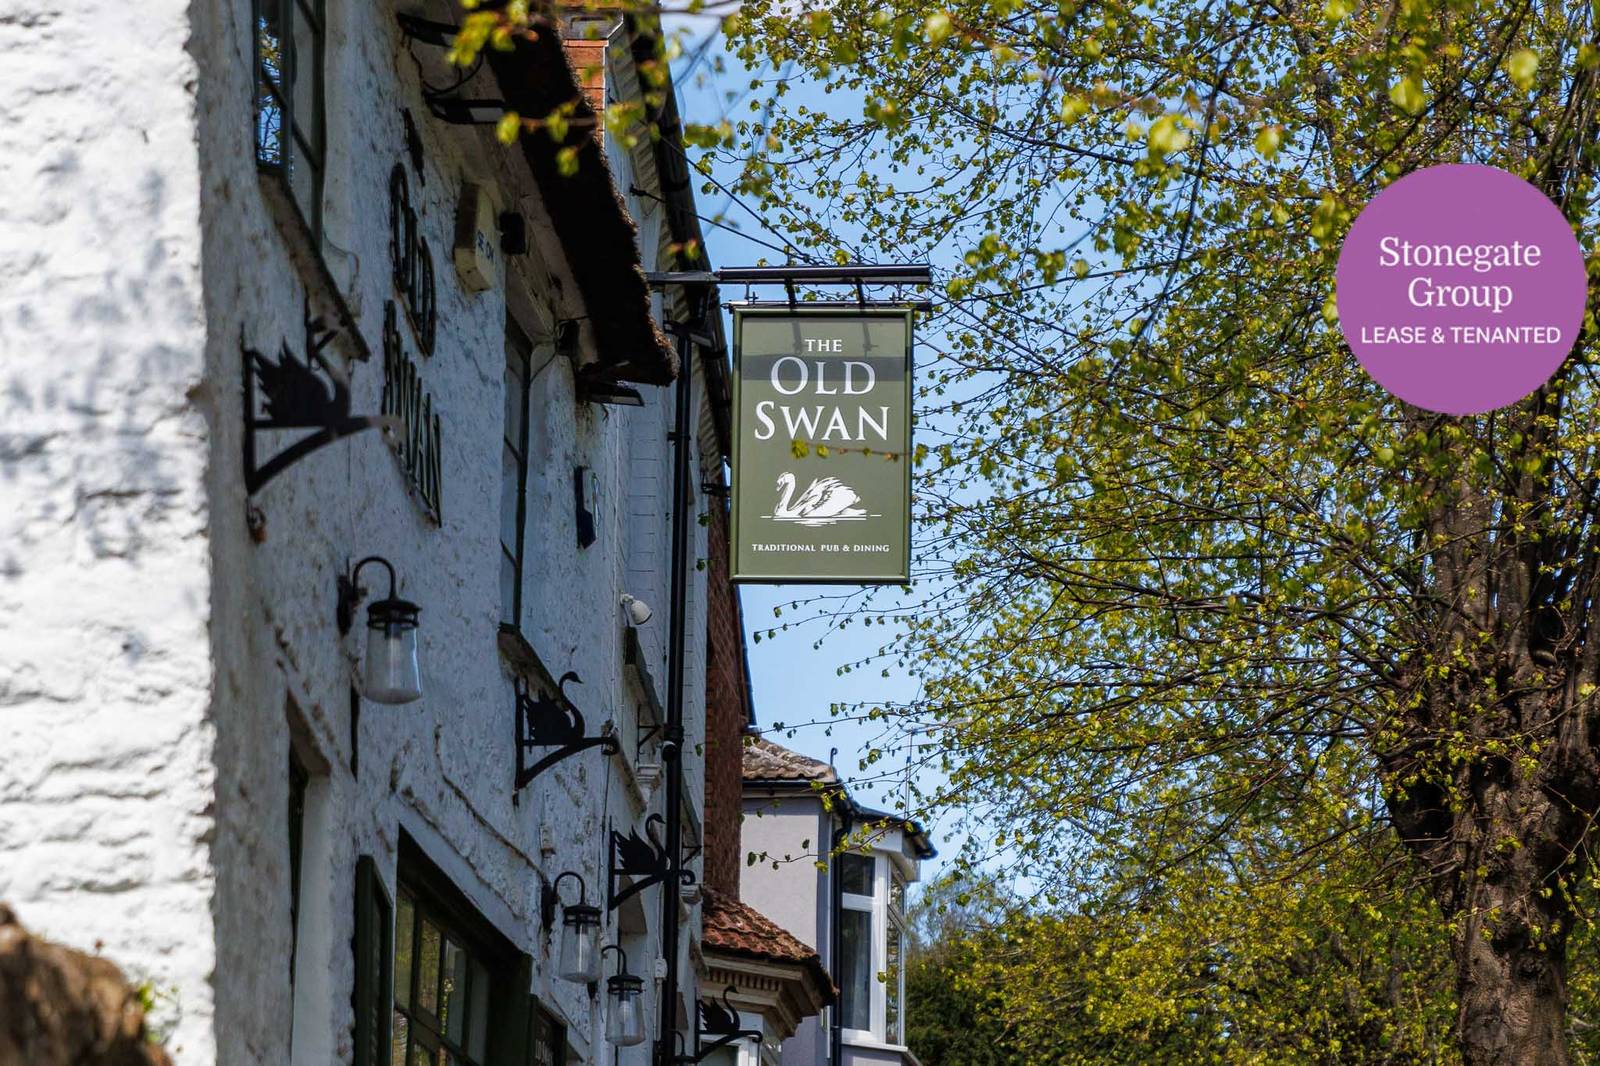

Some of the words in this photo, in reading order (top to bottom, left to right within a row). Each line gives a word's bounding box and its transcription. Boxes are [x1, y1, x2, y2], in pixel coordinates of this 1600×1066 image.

[804, 339, 843, 352] THE
[770, 356, 876, 395] OLD
[754, 400, 891, 441] SWAN
[751, 543, 816, 552] TRADITIONAL
[820, 544, 840, 552] PUB
[842, 544, 850, 552] &
[853, 544, 890, 552] DINING
